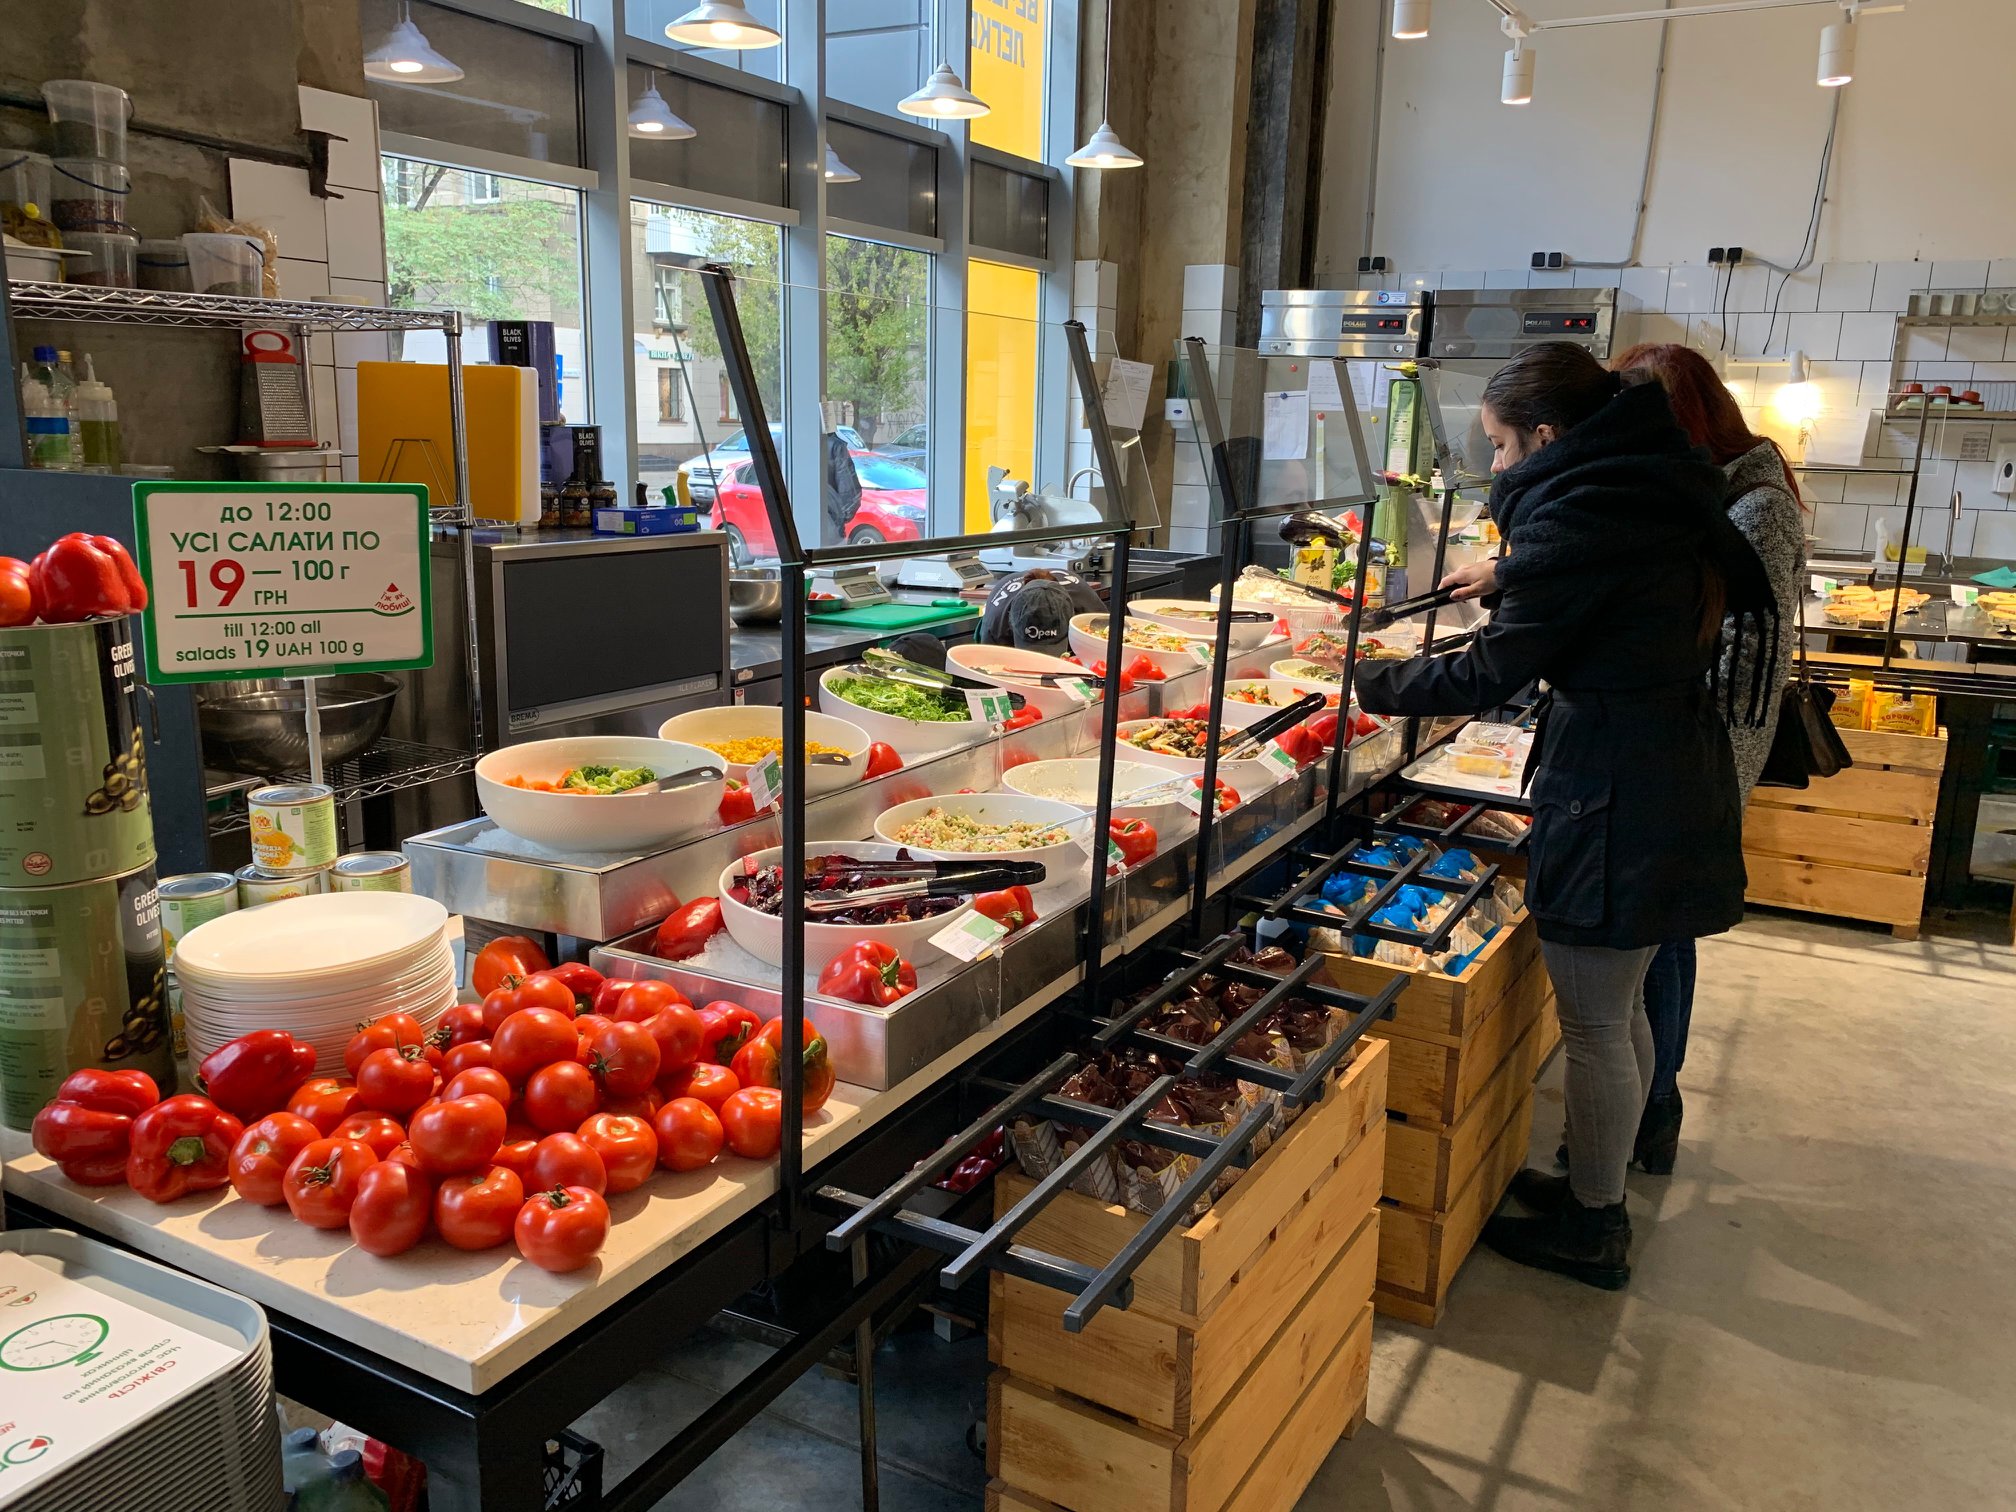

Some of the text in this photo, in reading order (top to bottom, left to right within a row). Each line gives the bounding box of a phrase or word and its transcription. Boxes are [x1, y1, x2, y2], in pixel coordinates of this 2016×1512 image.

[502, 328, 521, 336] BLACK
[578, 432, 595, 440] BLACK
[220, 502, 331, 524] до 12:00
[170, 530, 380, 552] УСІ САЛАТИ ПО
[178, 559, 350, 608] 19 100 г
[254, 590, 288, 606] ГРН
[224, 621, 321, 637] till 12:00 all
[176, 639, 364, 662] salads 19 UAH 100 g
[511, 711, 537, 722] BREMA
[138, 1338, 172, 1359] страв
[78, 1359, 156, 1404] виготовлення
[108, 1360, 177, 1399] СВІЖІСТЬ
